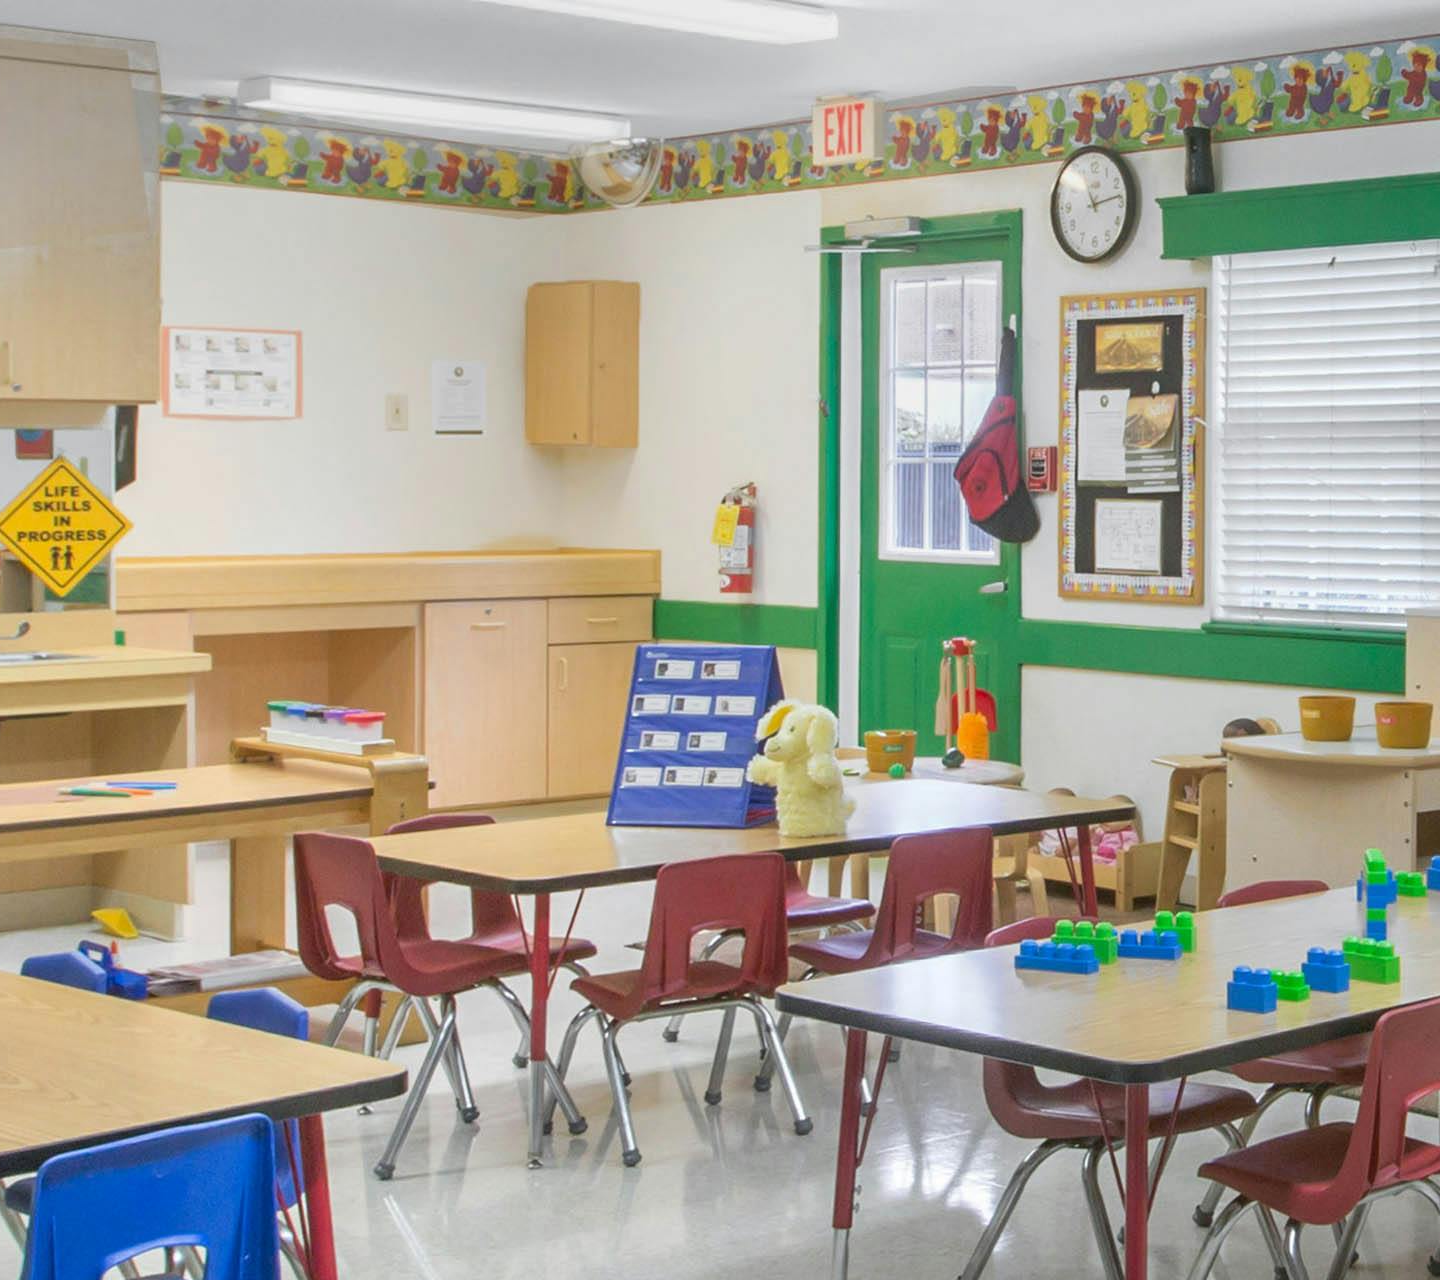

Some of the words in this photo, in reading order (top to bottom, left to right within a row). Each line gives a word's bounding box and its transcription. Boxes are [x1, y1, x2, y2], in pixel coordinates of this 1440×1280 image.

[824, 102, 865, 157] EXIT
[44, 486, 80, 497] LIFE
[32, 500, 92, 512] SKILLS
[53, 515, 71, 527] IN
[17, 529, 107, 542] PROGRESS
